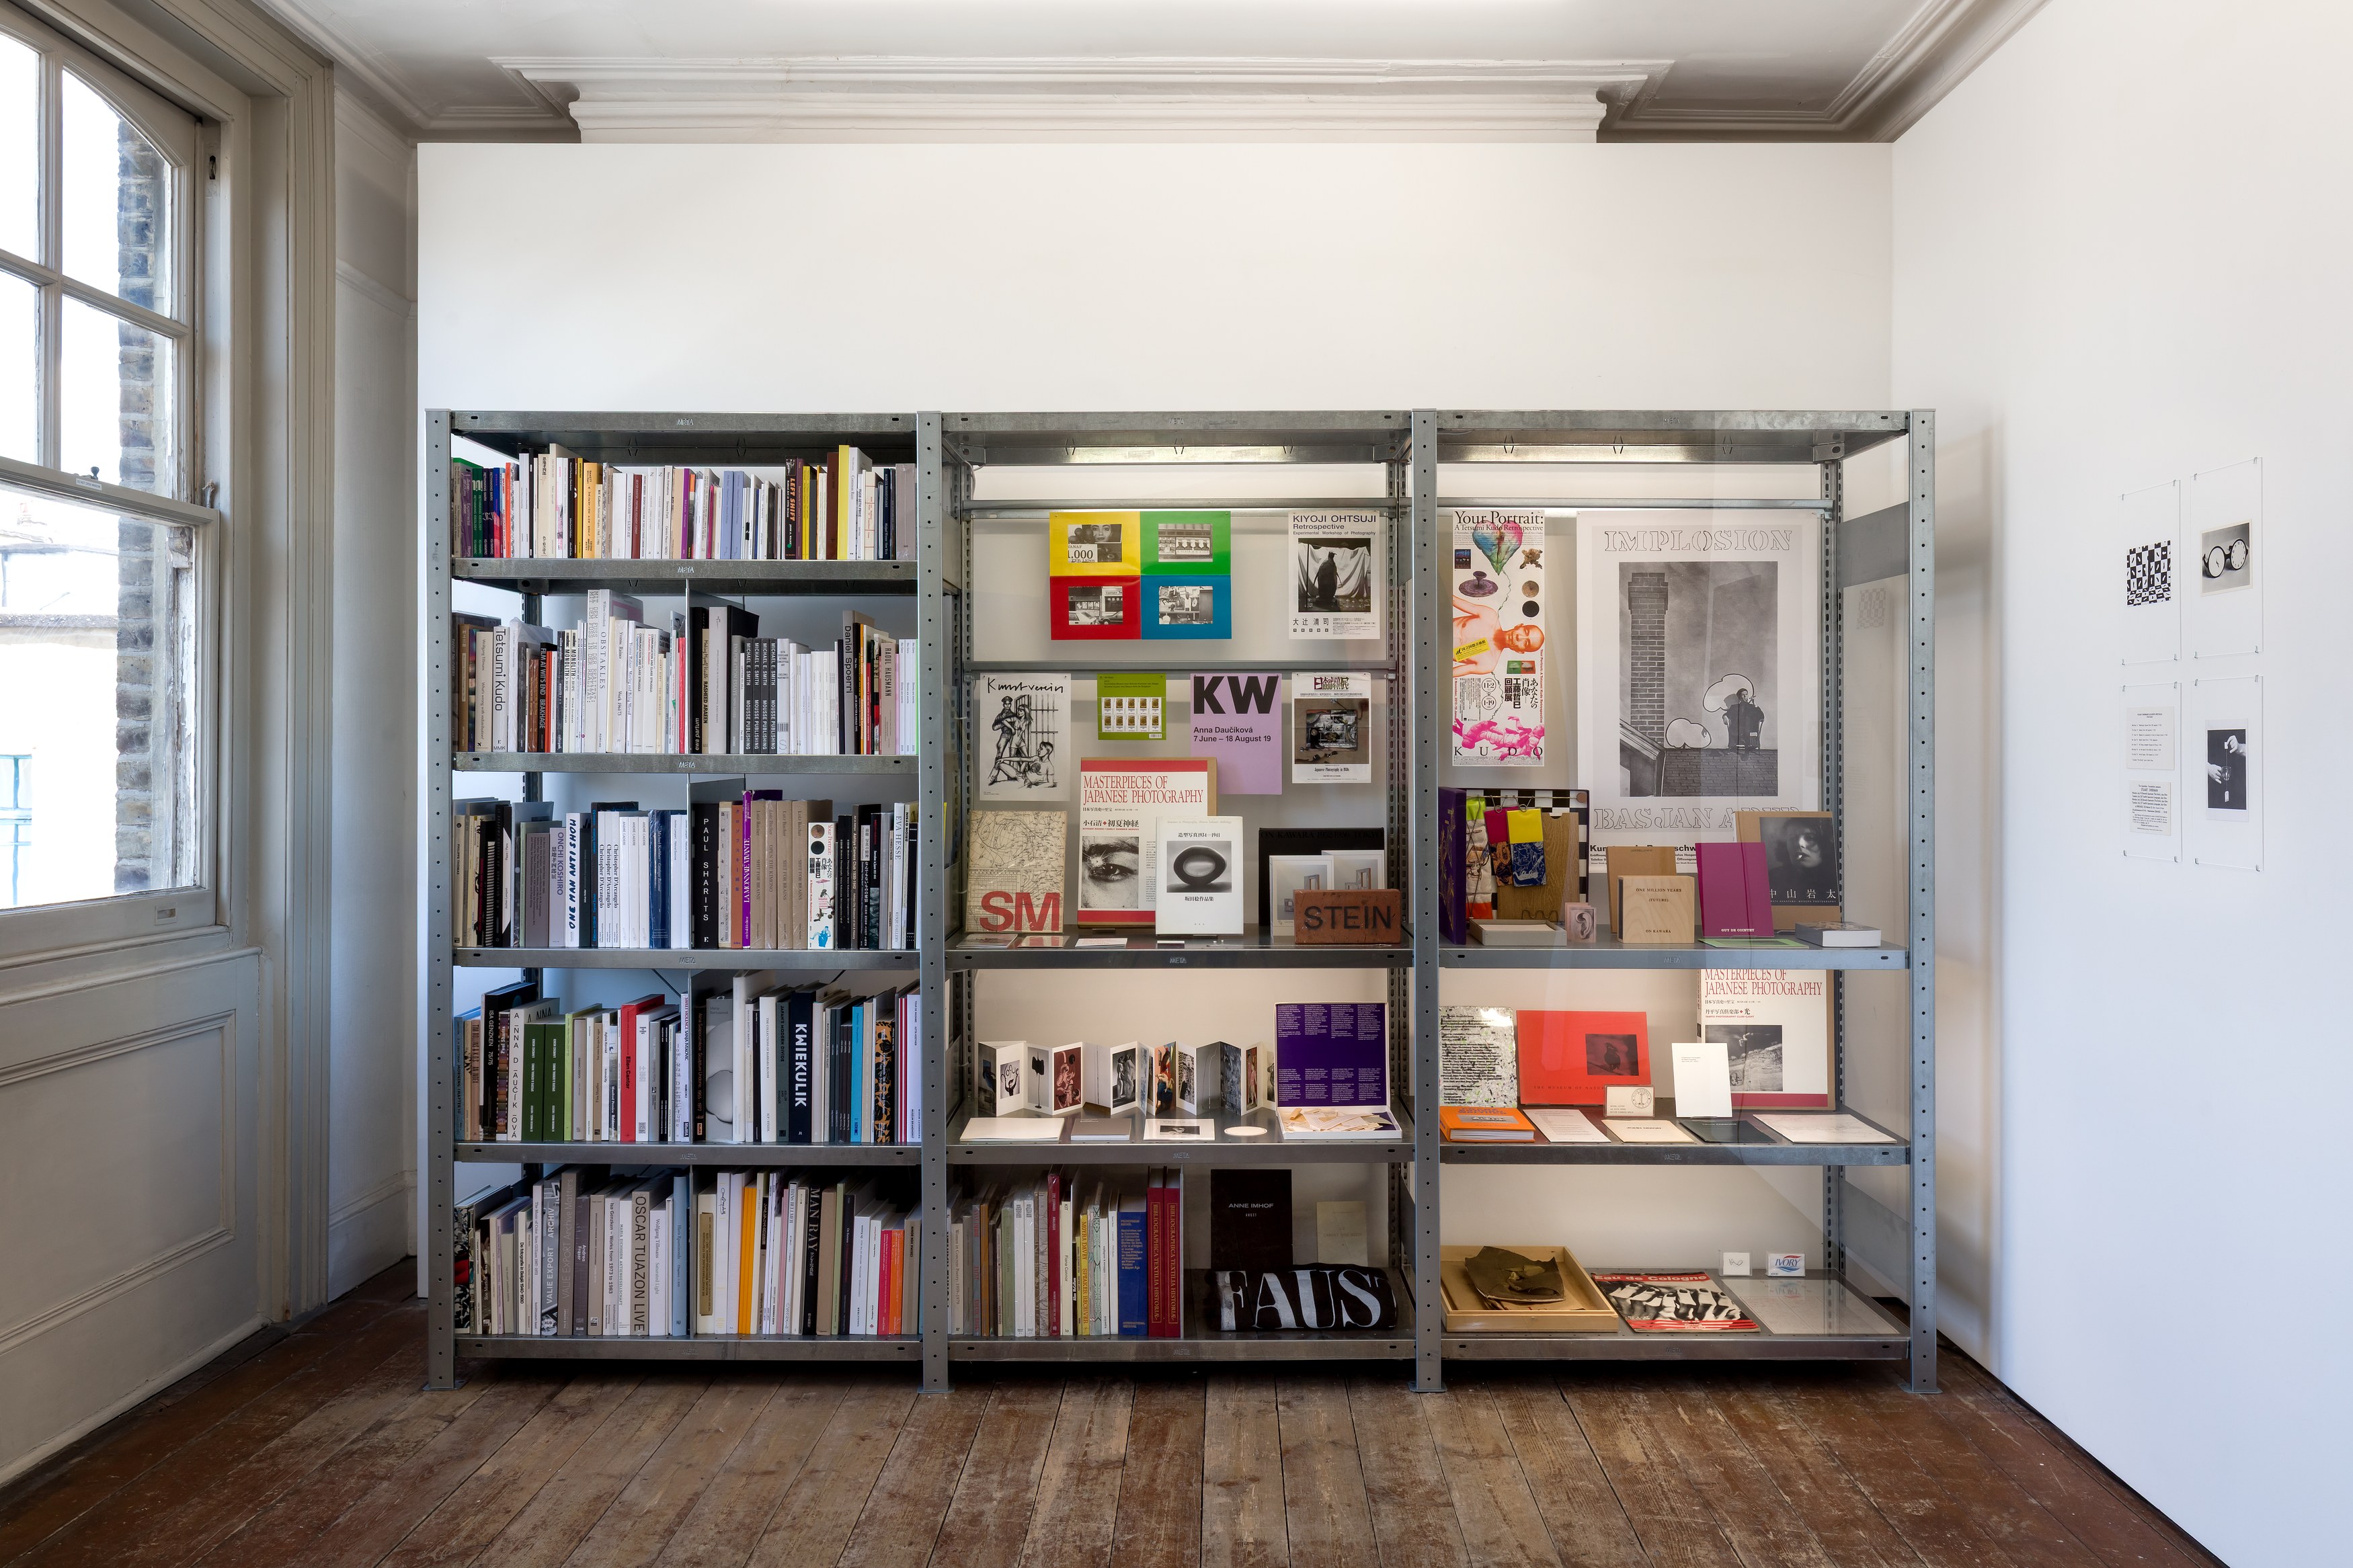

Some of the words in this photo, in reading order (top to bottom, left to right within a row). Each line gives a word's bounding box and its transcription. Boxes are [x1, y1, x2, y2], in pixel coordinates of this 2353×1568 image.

[1455, 511, 1486, 524] Your
[1490, 511, 1543, 524] Portrait:
[1605, 530, 1792, 551] IMPLOSION
[495, 629, 506, 677] Tetsumi
[495, 681, 506, 710] Kudo
[988, 677, 1063, 693] Kunstverein
[1194, 676, 1279, 714] KW
[1084, 776, 1152, 789] MASTERPIECES
[1156, 776, 1168, 789] OF
[1084, 790, 1127, 805] JAPANESE
[1132, 790, 1203, 802] PHOTOGRAPHY
[980, 891, 1060, 932] SM
[1304, 905, 1392, 930] STEIN
[1705, 969, 1771, 981] MASTERPIECES
[1775, 969, 1786, 981] OF
[1706, 982, 1748, 997] JAPANESE
[1752, 982, 1823, 995] PHOTOGRAPHY
[795, 1024, 807, 1107] KWIEKULIK
[635, 1196, 646, 1241] OSCAR
[809, 1188, 820, 1222] MAN
[807, 1223, 818, 1251] RAY
[635, 1245, 645, 1298] TUAZON
[634, 1304, 645, 1331] LIVE
